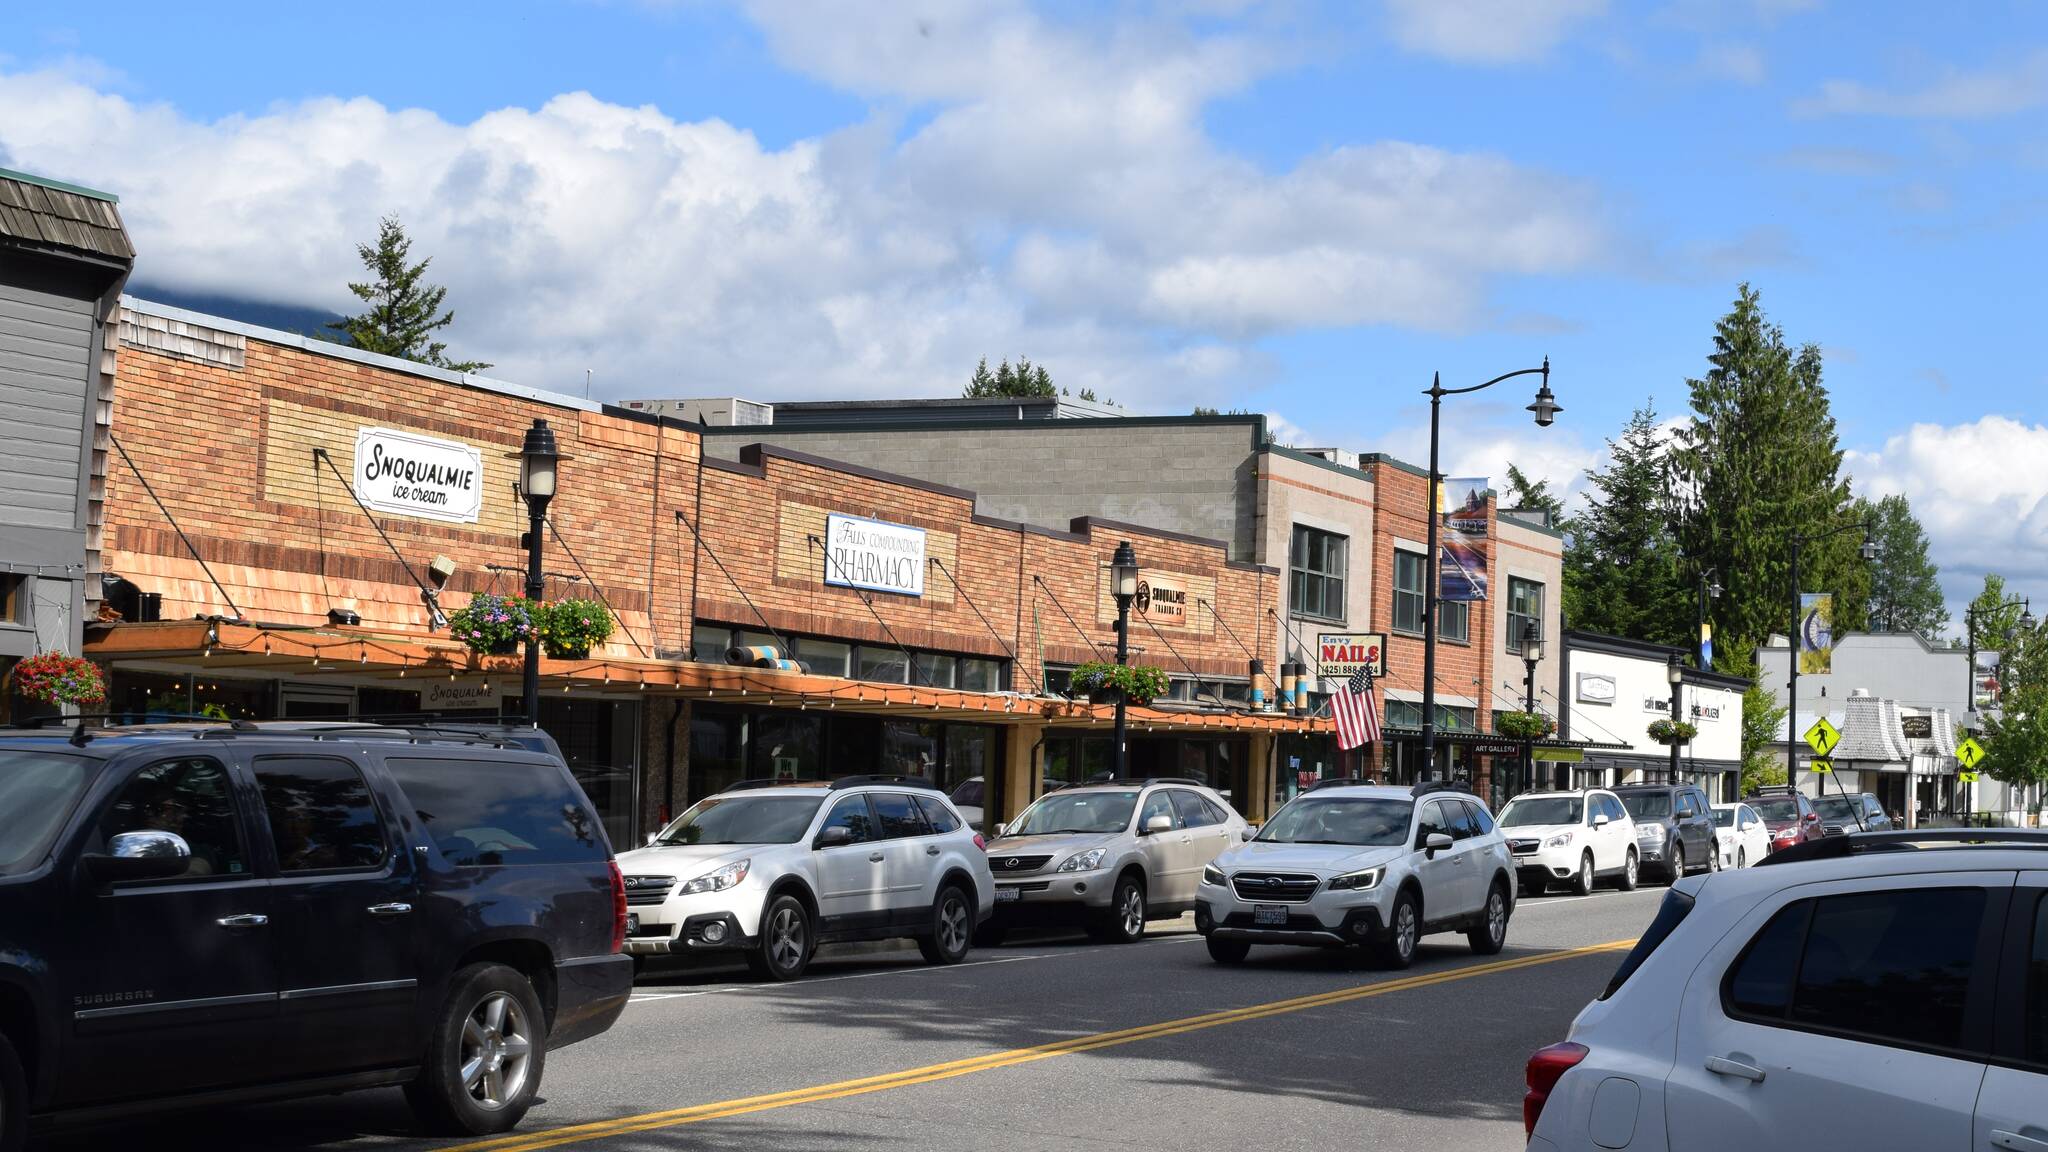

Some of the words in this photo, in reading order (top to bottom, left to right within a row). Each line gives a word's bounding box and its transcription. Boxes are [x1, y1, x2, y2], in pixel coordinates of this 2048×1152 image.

[366, 443, 474, 490] SNOQUALMIE
[393, 481, 410, 499] ice
[411, 488, 448, 506] cream
[869, 533, 920, 555] COMPOUNDING
[833, 547, 919, 589] PHARMACY
[1152, 587, 1186, 605] SNOQUALMIE
[1322, 636, 1351, 645] Envy
[1321, 645, 1379, 663] NAILS
[1322, 665, 1341, 674] (425)
[430, 684, 493, 702] SNOQUALMIE
[1488, 745, 1516, 753] GALLERY
[74, 989, 154, 1005] SUBURBAN
